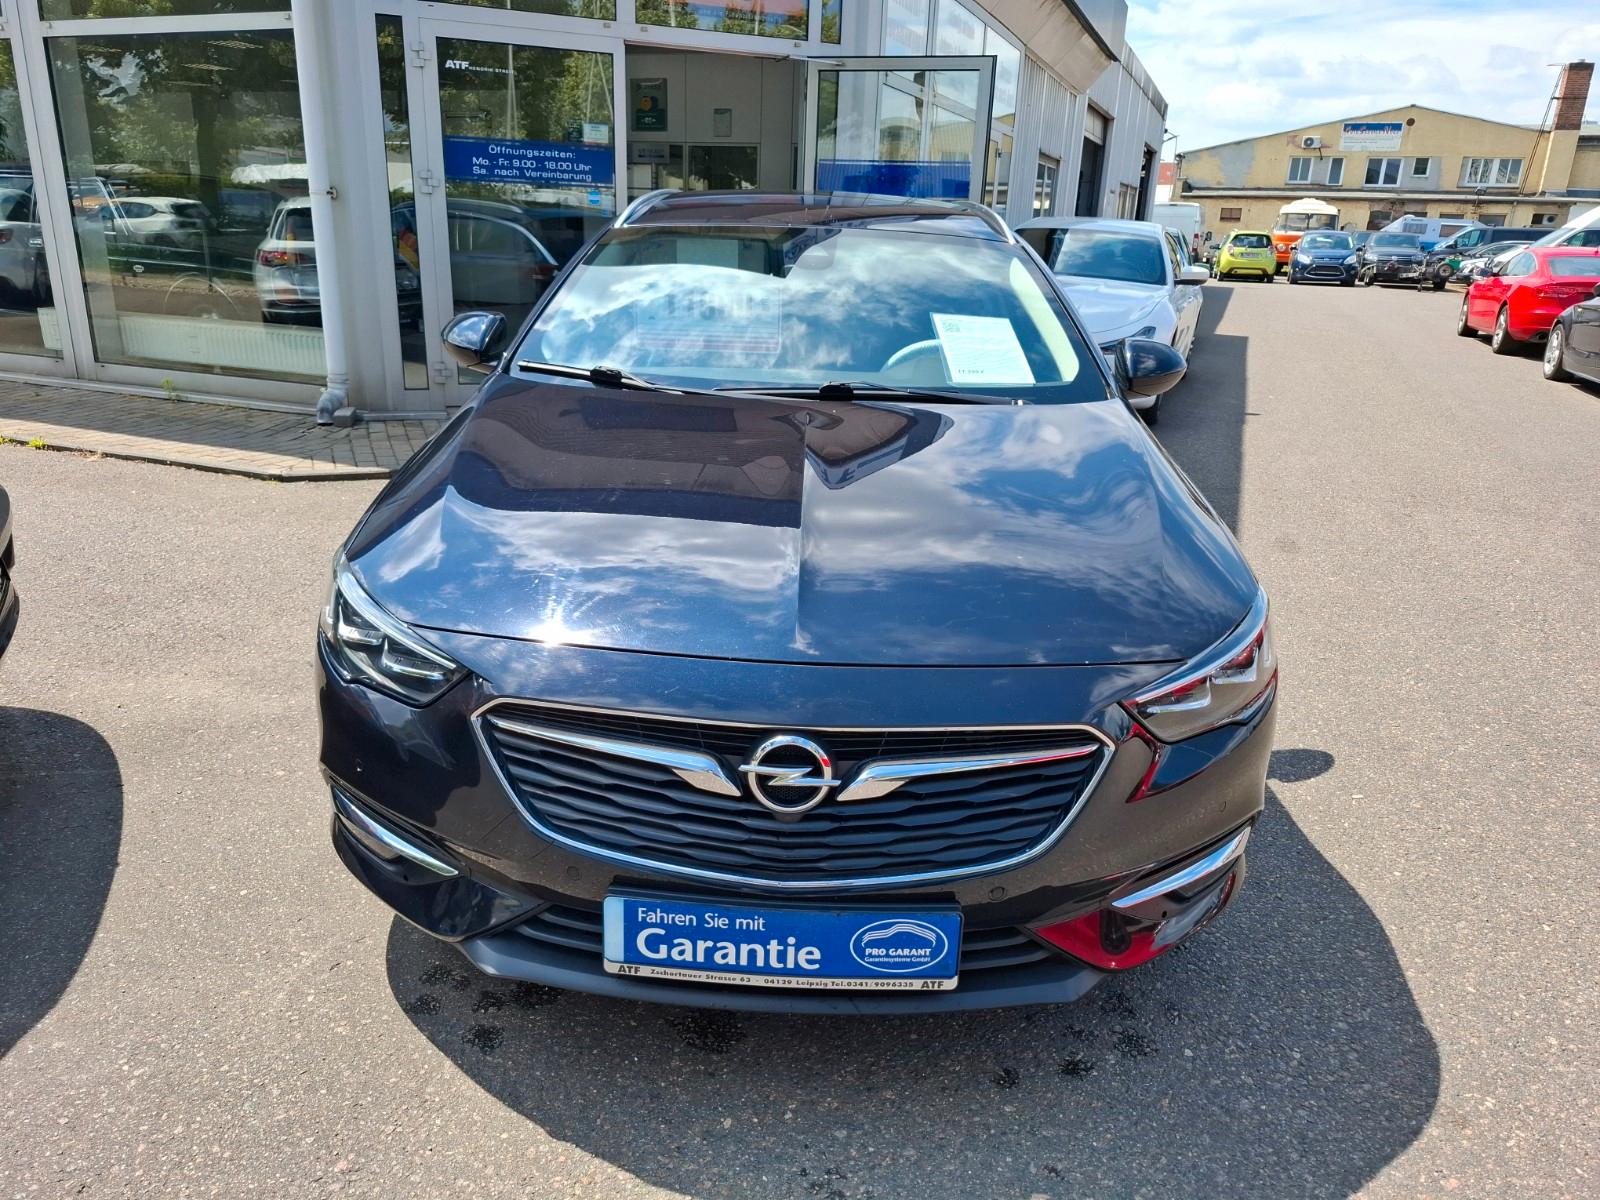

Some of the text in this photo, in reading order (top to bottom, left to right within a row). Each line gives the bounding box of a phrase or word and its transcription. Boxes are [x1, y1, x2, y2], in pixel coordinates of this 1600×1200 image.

[445, 60, 469, 69] ATF
[488, 144, 577, 159] Öffnungszeiten:
[472, 156, 492, 166] Mo.
[498, 158, 511, 167] Fr.
[512, 159, 537, 168] 9.00
[543, 161, 572, 171] 18.00
[573, 163, 593, 172] Uhr
[472, 166, 593, 182] Sa. nach Vereinbarung
[638, 907, 767, 932] Fahren Sie mit
[636, 928, 821, 970] Garantie
[865, 948, 932, 957] PRO GARANT
[617, 964, 641, 975] ATF
[650, 968, 703, 979] Zschortauer
[705, 973, 738, 983] Strasse
[796, 979, 829, 988] Leipzig
[920, 980, 945, 990] ATF
